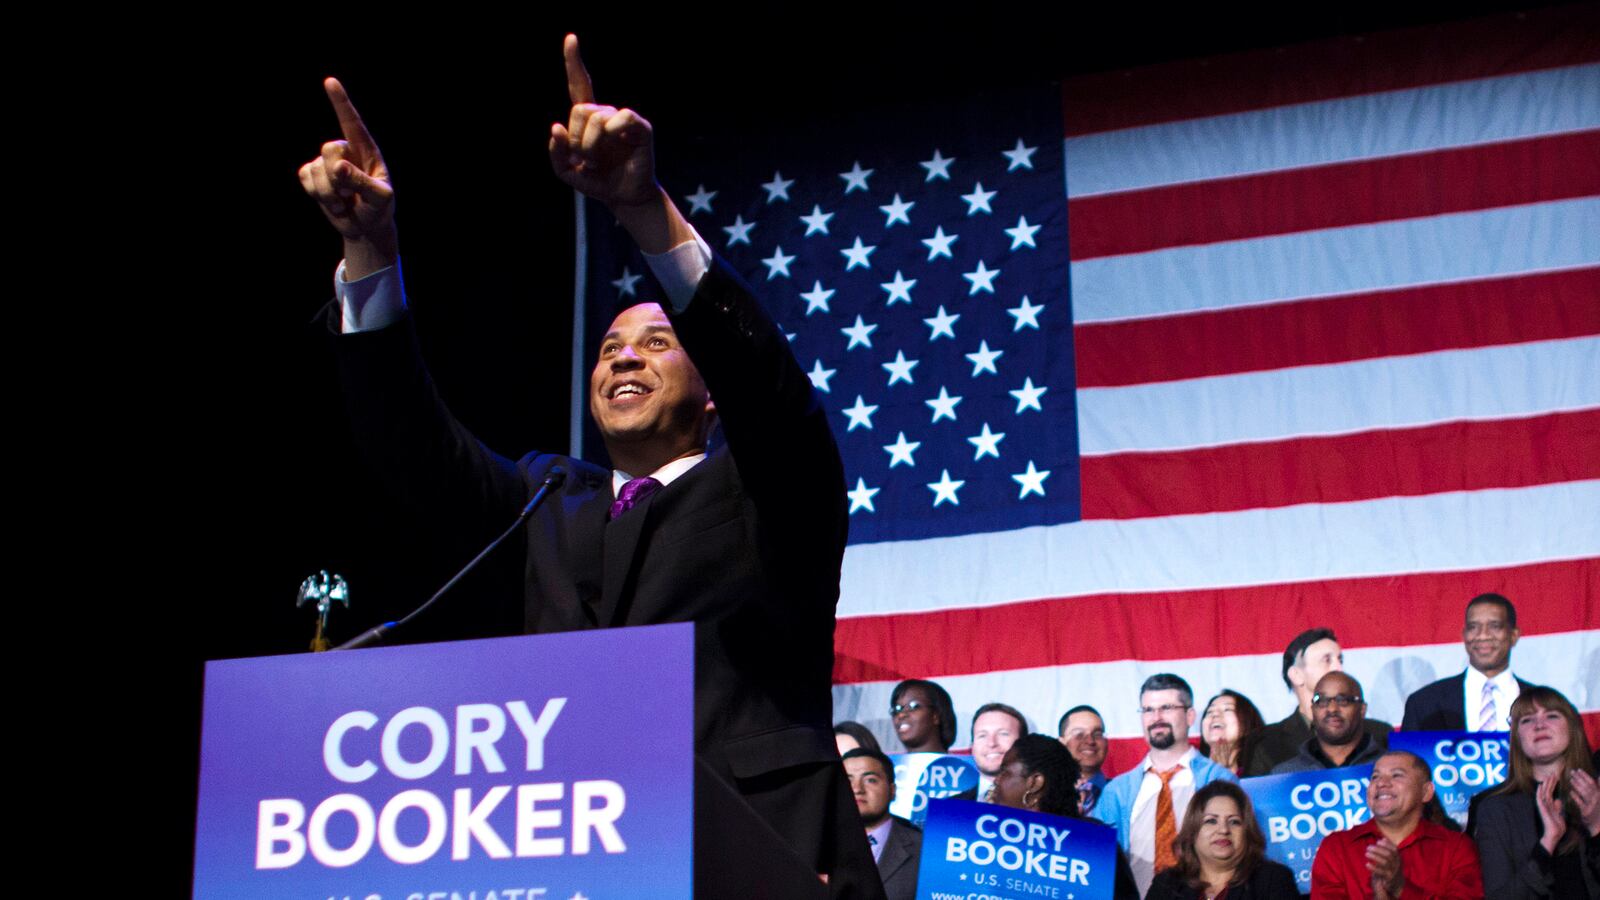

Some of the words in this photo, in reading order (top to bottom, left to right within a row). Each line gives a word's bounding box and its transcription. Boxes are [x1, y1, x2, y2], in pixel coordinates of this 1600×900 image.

[323, 697, 568, 783] CORY
[1433, 763, 1506, 787] OOK
[255, 779, 627, 869] BOOKER
[975, 814, 1071, 852] CORY
[1268, 806, 1368, 843] BOOK
[945, 837, 1090, 886] BOOKER
[974, 873, 1001, 887] U.S.
[1006, 878, 1060, 899] SENATE
